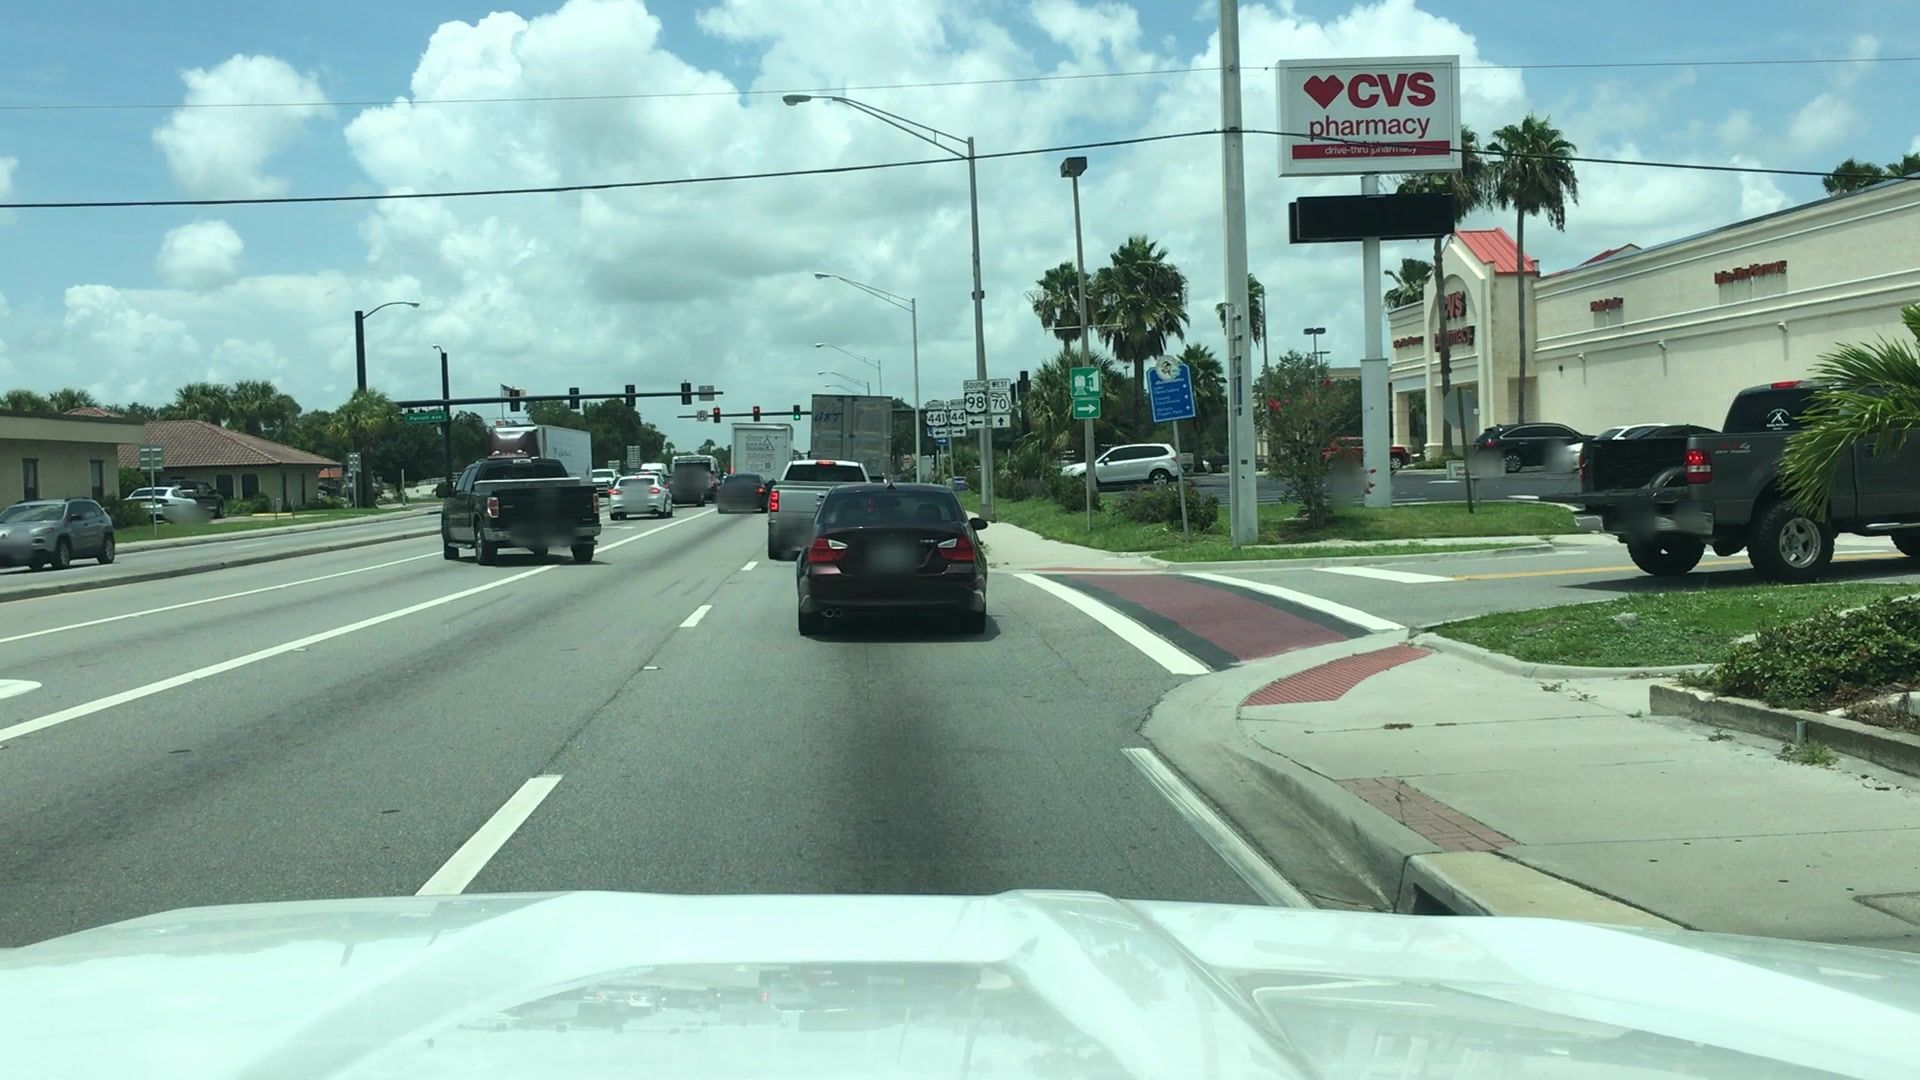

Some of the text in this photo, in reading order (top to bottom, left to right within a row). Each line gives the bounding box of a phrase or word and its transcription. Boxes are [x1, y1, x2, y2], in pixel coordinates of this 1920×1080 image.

[1347, 71, 1436, 109] CVS
[1309, 115, 1431, 142] pharmacy
[1324, 146, 1369, 155] drive-thru
[967, 396, 985, 409] 98
[992, 399, 1007, 410] 70
[928, 413, 945, 423] 441
